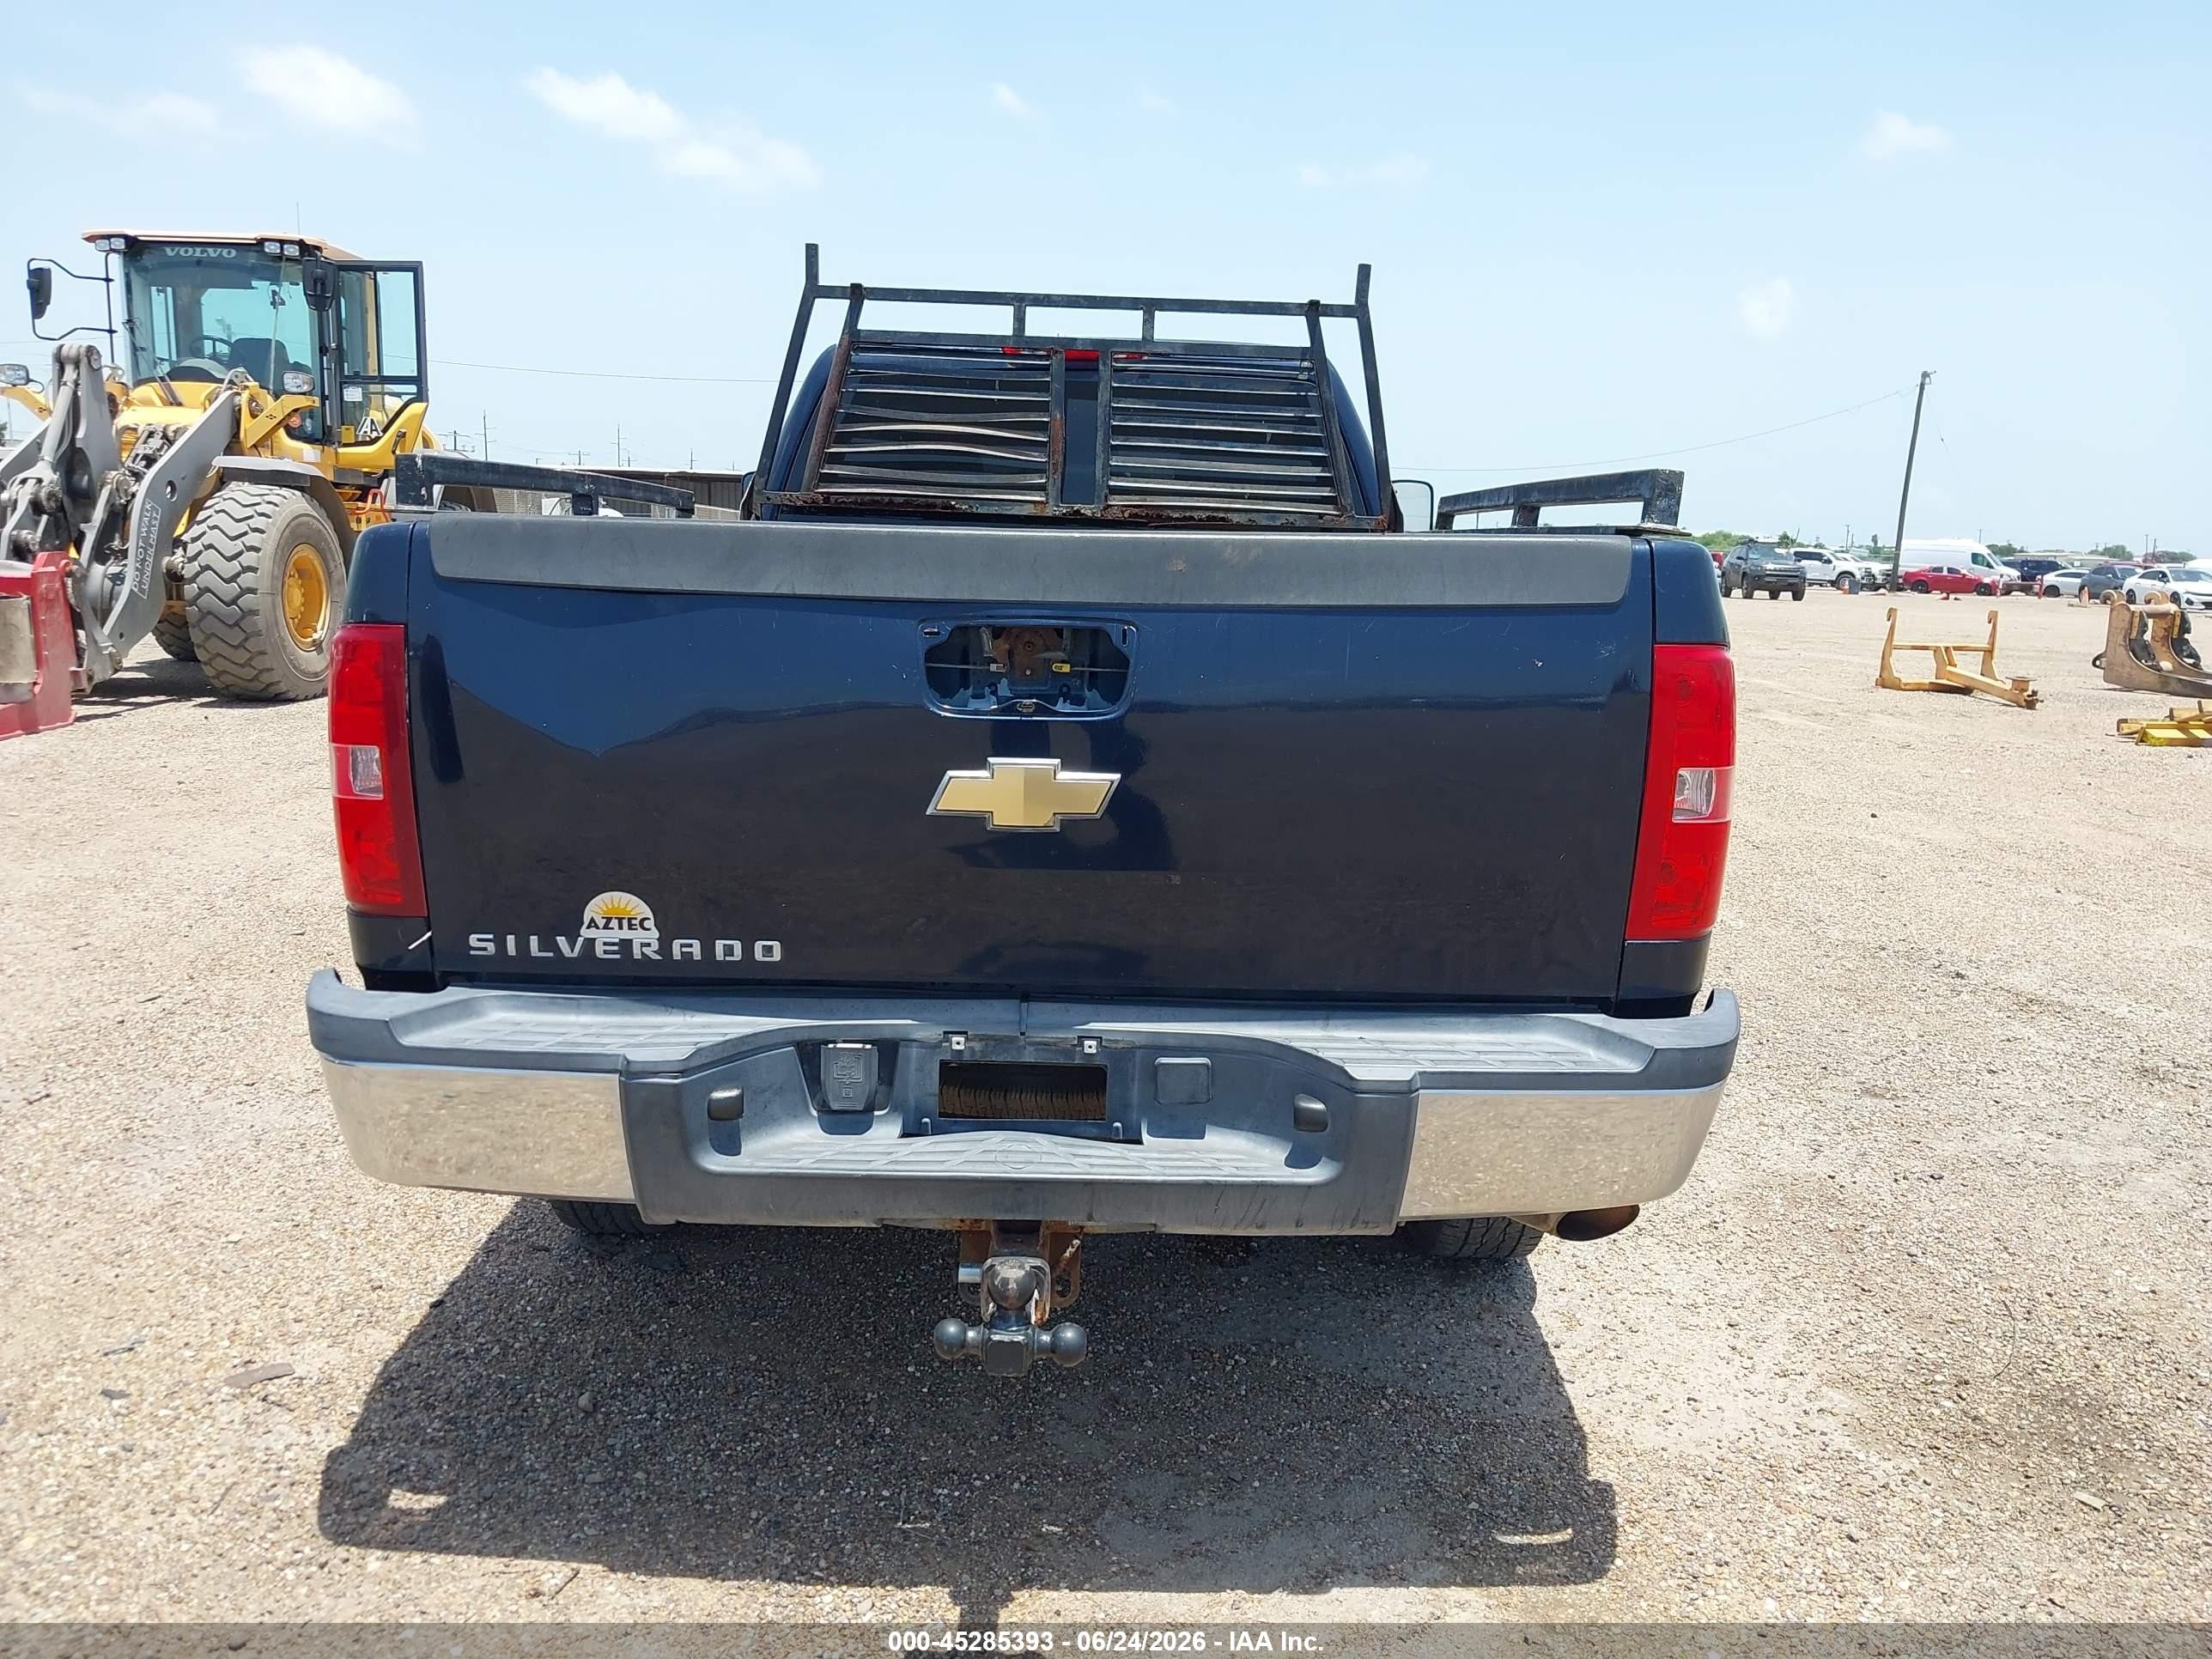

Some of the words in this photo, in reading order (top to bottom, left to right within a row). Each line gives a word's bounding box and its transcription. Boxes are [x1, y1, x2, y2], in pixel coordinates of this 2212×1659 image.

[164, 247, 237, 258] VOLVO
[131, 572, 141, 592] DO
[136, 539, 146, 568] NOT
[141, 501, 153, 537] WALK
[142, 546, 155, 590] UNDER
[586, 916, 652, 932] AZTEC
[469, 933, 782, 962] SILVERADO
